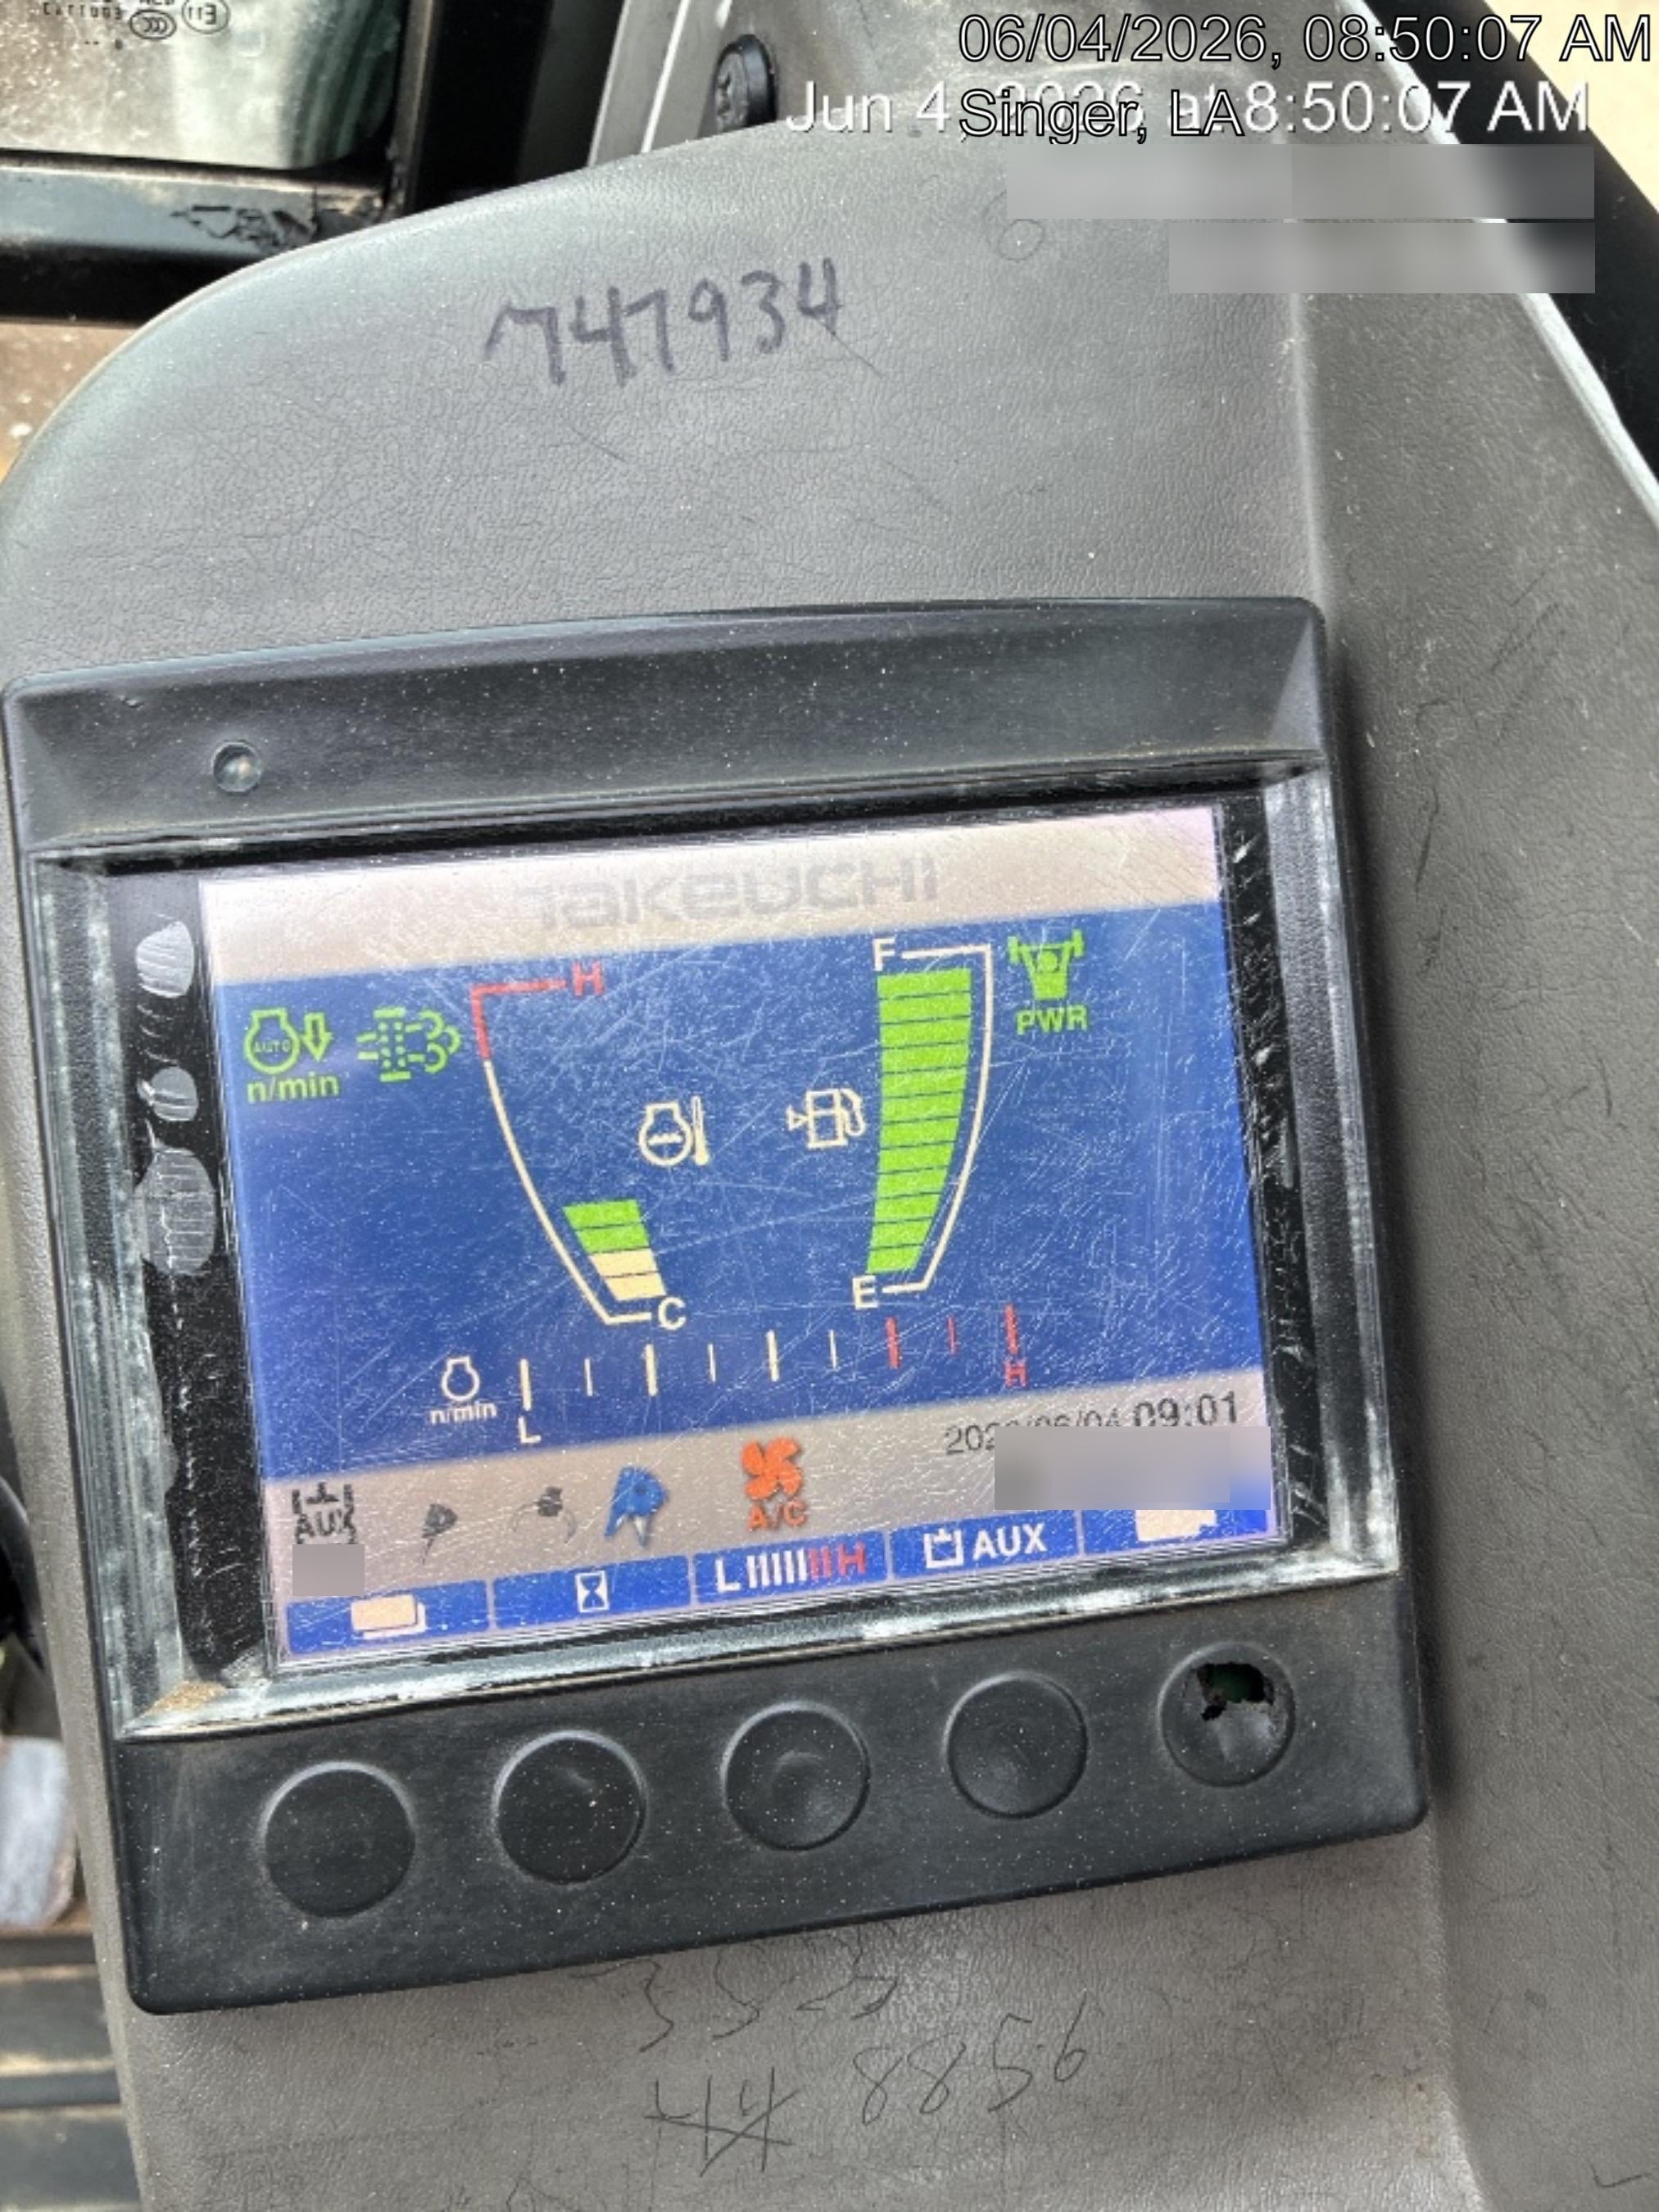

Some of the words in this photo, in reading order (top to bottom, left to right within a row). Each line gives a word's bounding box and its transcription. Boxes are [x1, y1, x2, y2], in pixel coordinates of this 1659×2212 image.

[872, 936, 897, 972] F
[573, 960, 605, 996] H
[1015, 1004, 1089, 1036] PWR
[247, 1071, 340, 1104] n/min
[851, 1274, 879, 1311] E
[656, 1296, 687, 1331] C
[1003, 1357, 1030, 1388] H
[429, 1399, 498, 1426] n/min
[517, 1415, 542, 1444] L
[746, 1499, 808, 1532] A/C
[972, 1521, 1048, 1562] AUX
